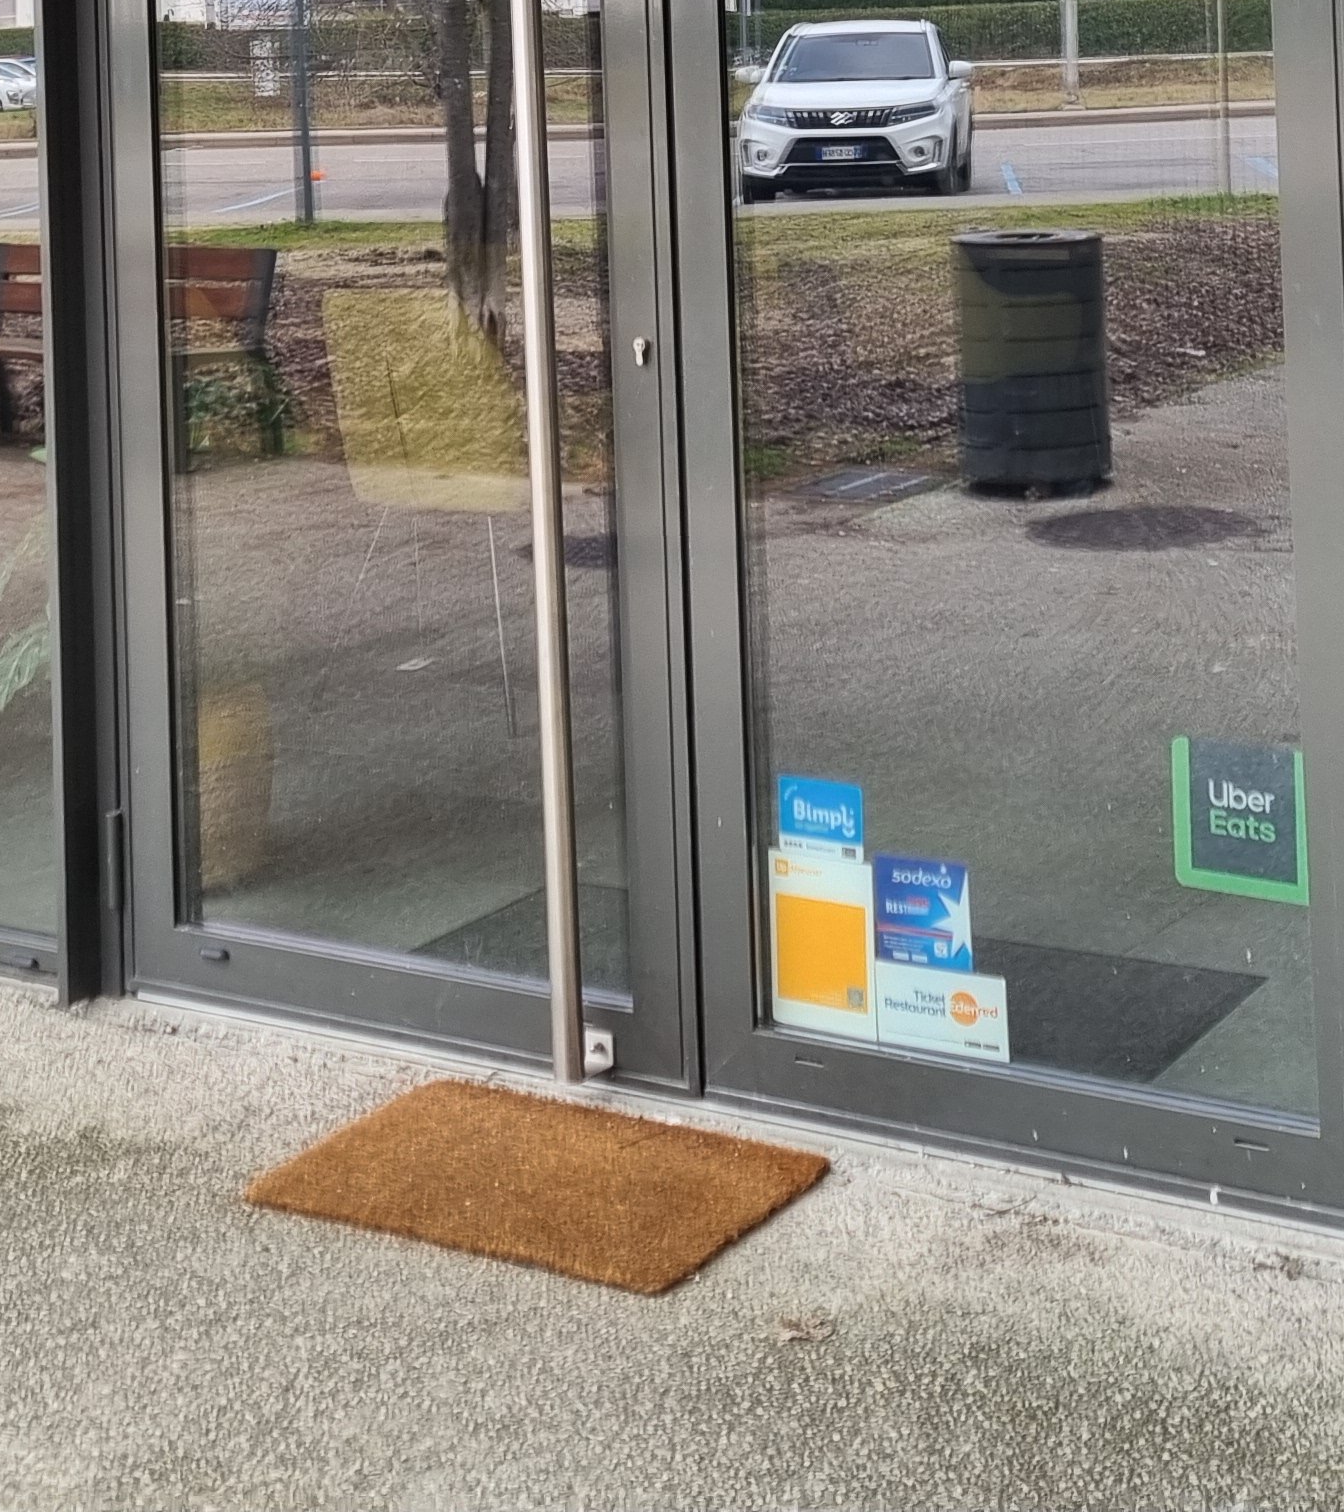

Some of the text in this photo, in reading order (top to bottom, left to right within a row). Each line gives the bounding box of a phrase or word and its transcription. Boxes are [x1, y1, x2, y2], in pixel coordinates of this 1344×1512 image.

[1207, 778, 1275, 814] Uber
[1209, 807, 1276, 844] Eats
[891, 867, 953, 890] sodexo
[884, 997, 946, 1018] Restaurant
